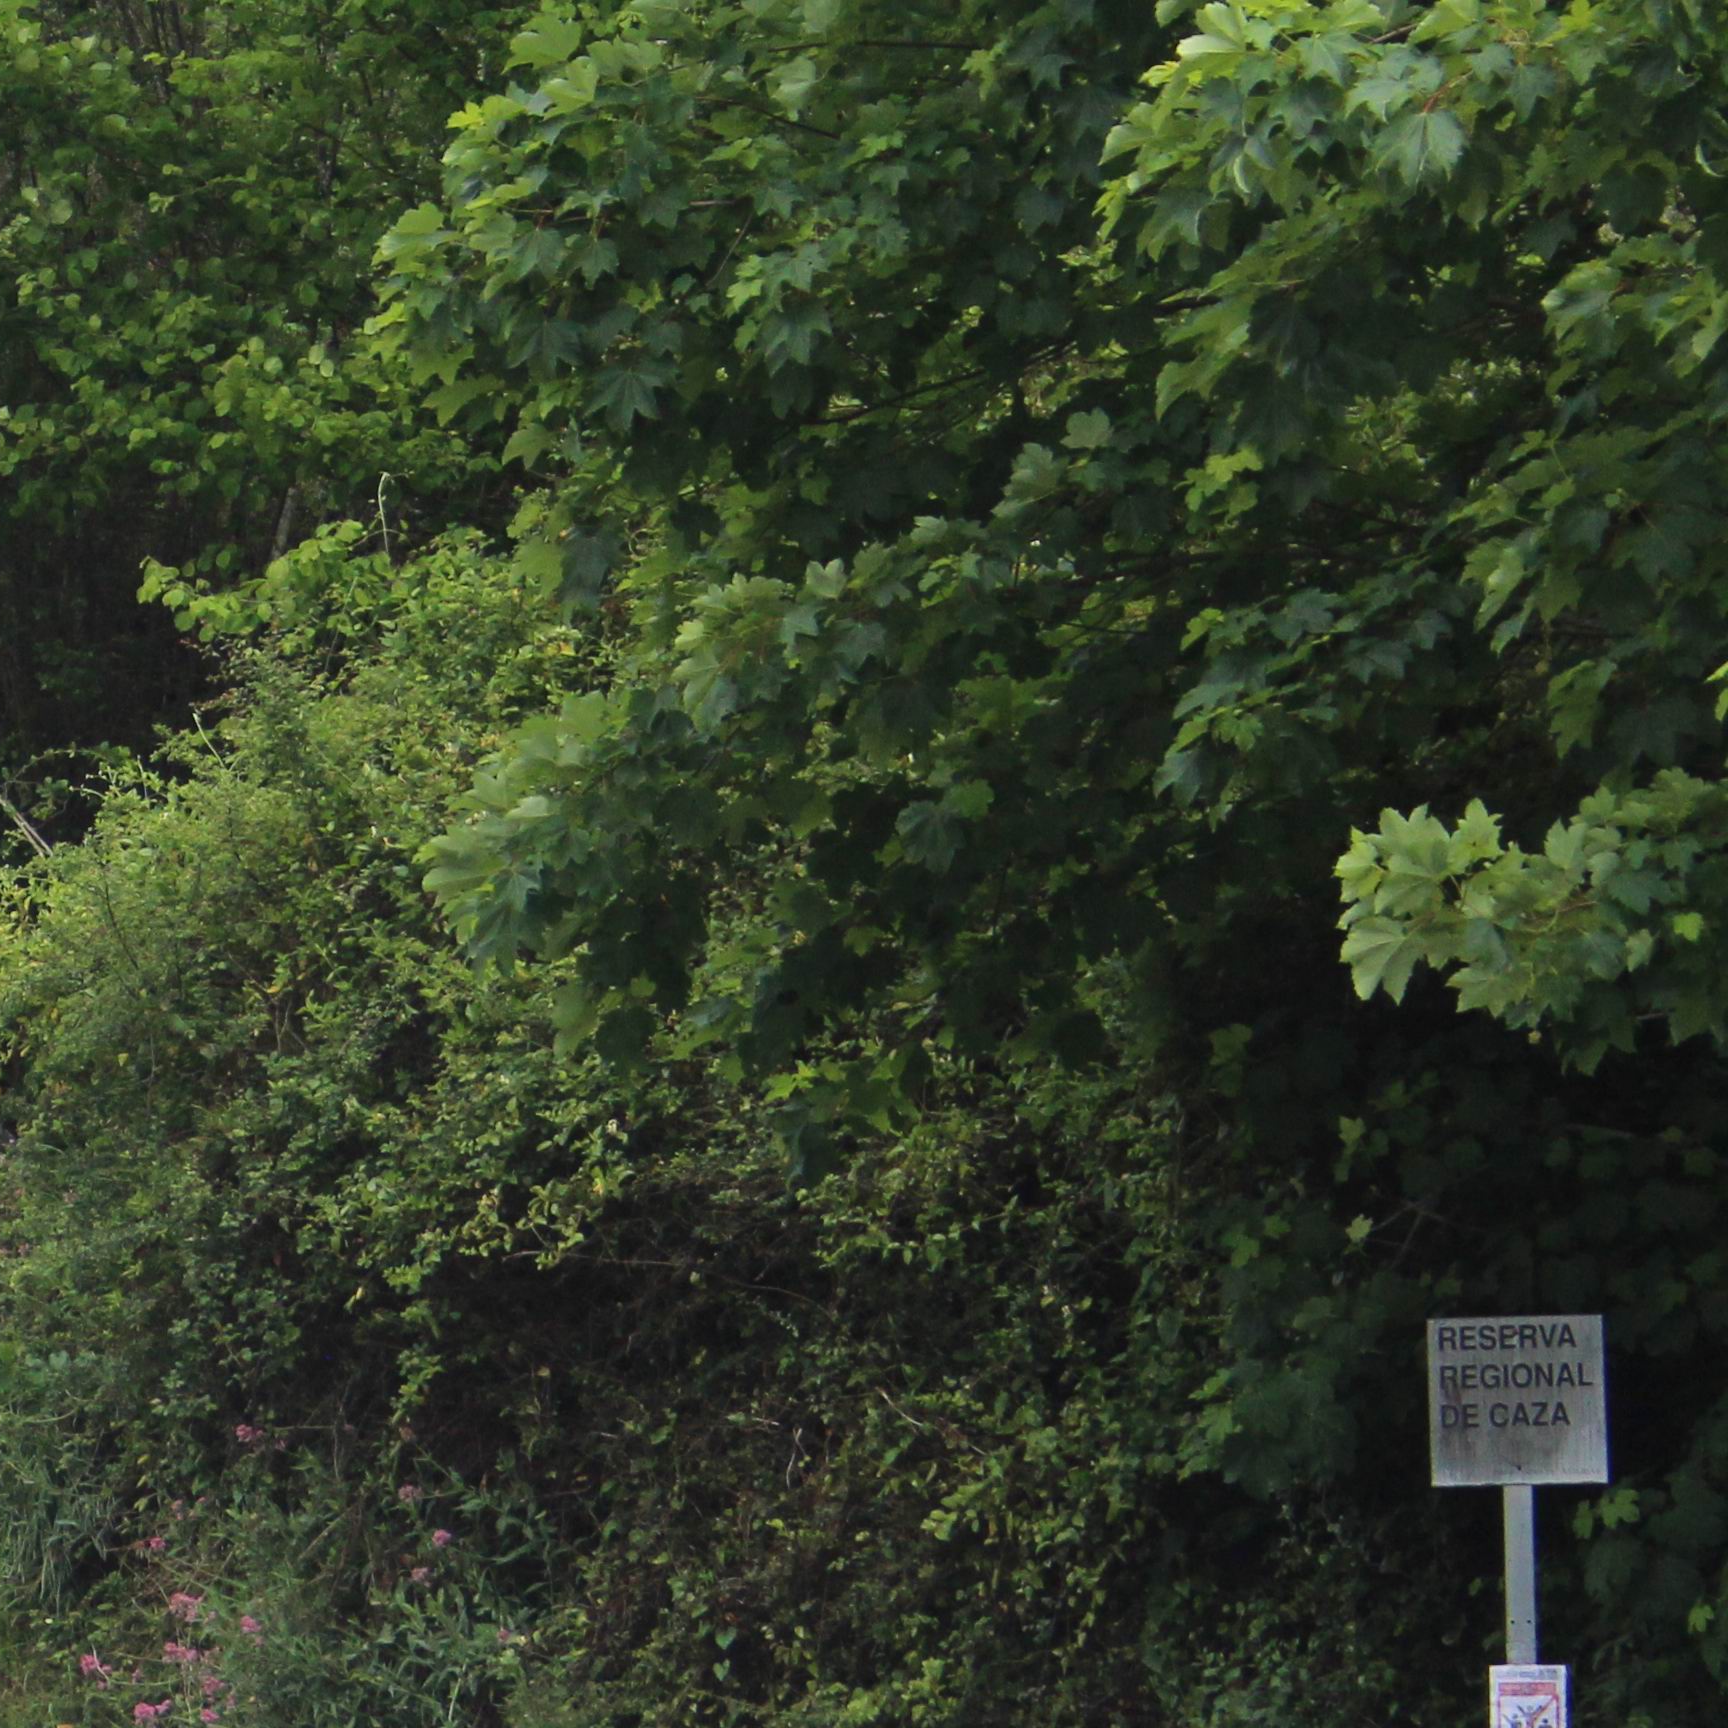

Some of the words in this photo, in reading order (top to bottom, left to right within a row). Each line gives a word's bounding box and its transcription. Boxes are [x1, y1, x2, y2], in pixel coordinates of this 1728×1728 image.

[1438, 1324, 1577, 1352] RESERVA
[1439, 1362, 1594, 1390] REGIONAL
[1440, 1404, 1479, 1429] DE
[1489, 1402, 1571, 1428] CAZA
